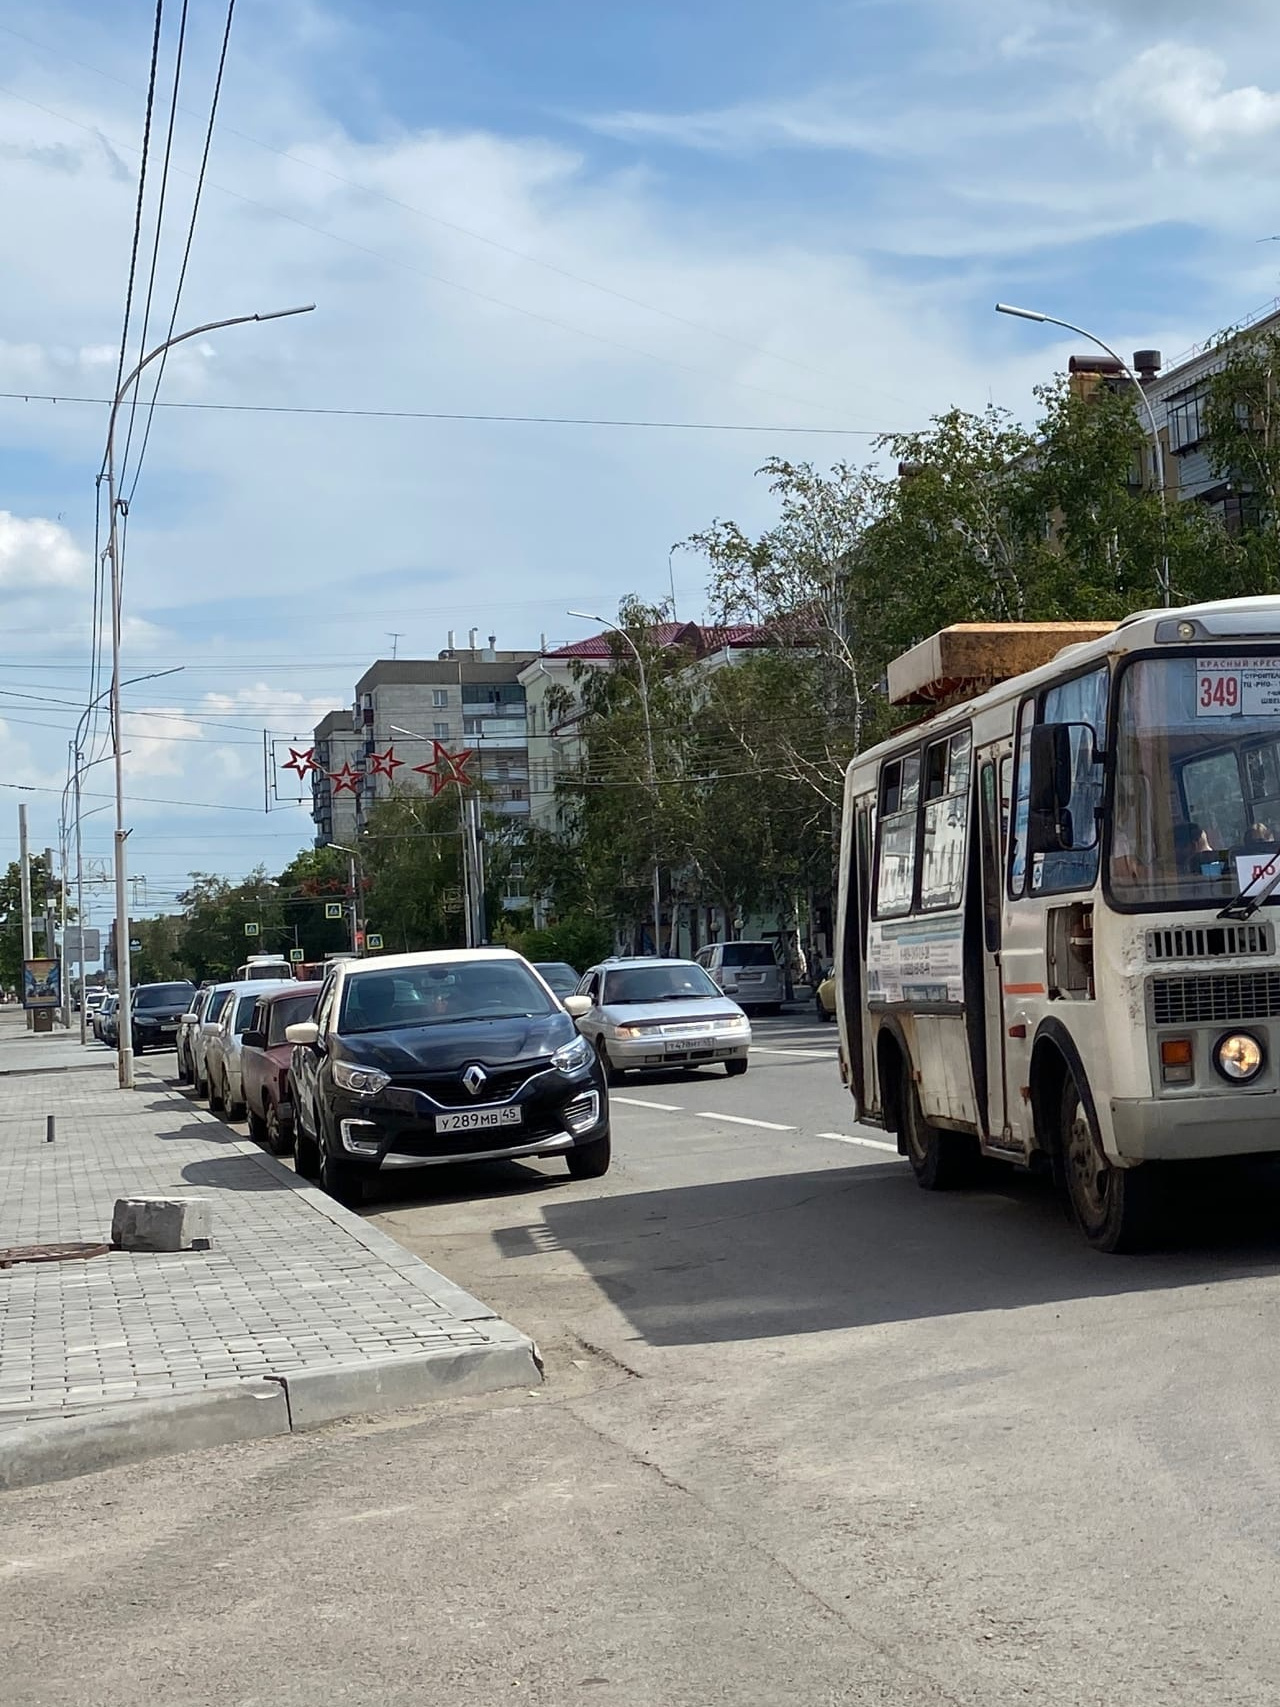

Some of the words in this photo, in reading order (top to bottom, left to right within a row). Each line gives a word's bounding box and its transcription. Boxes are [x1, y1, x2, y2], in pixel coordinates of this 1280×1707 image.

[1200, 660, 1249, 668] КРАСНЫЙ
[1200, 677, 1238, 708] 349
[1252, 865, 1276, 880] до
[441, 1113, 498, 1130] У289МВ
[502, 1108, 516, 1119] 45
